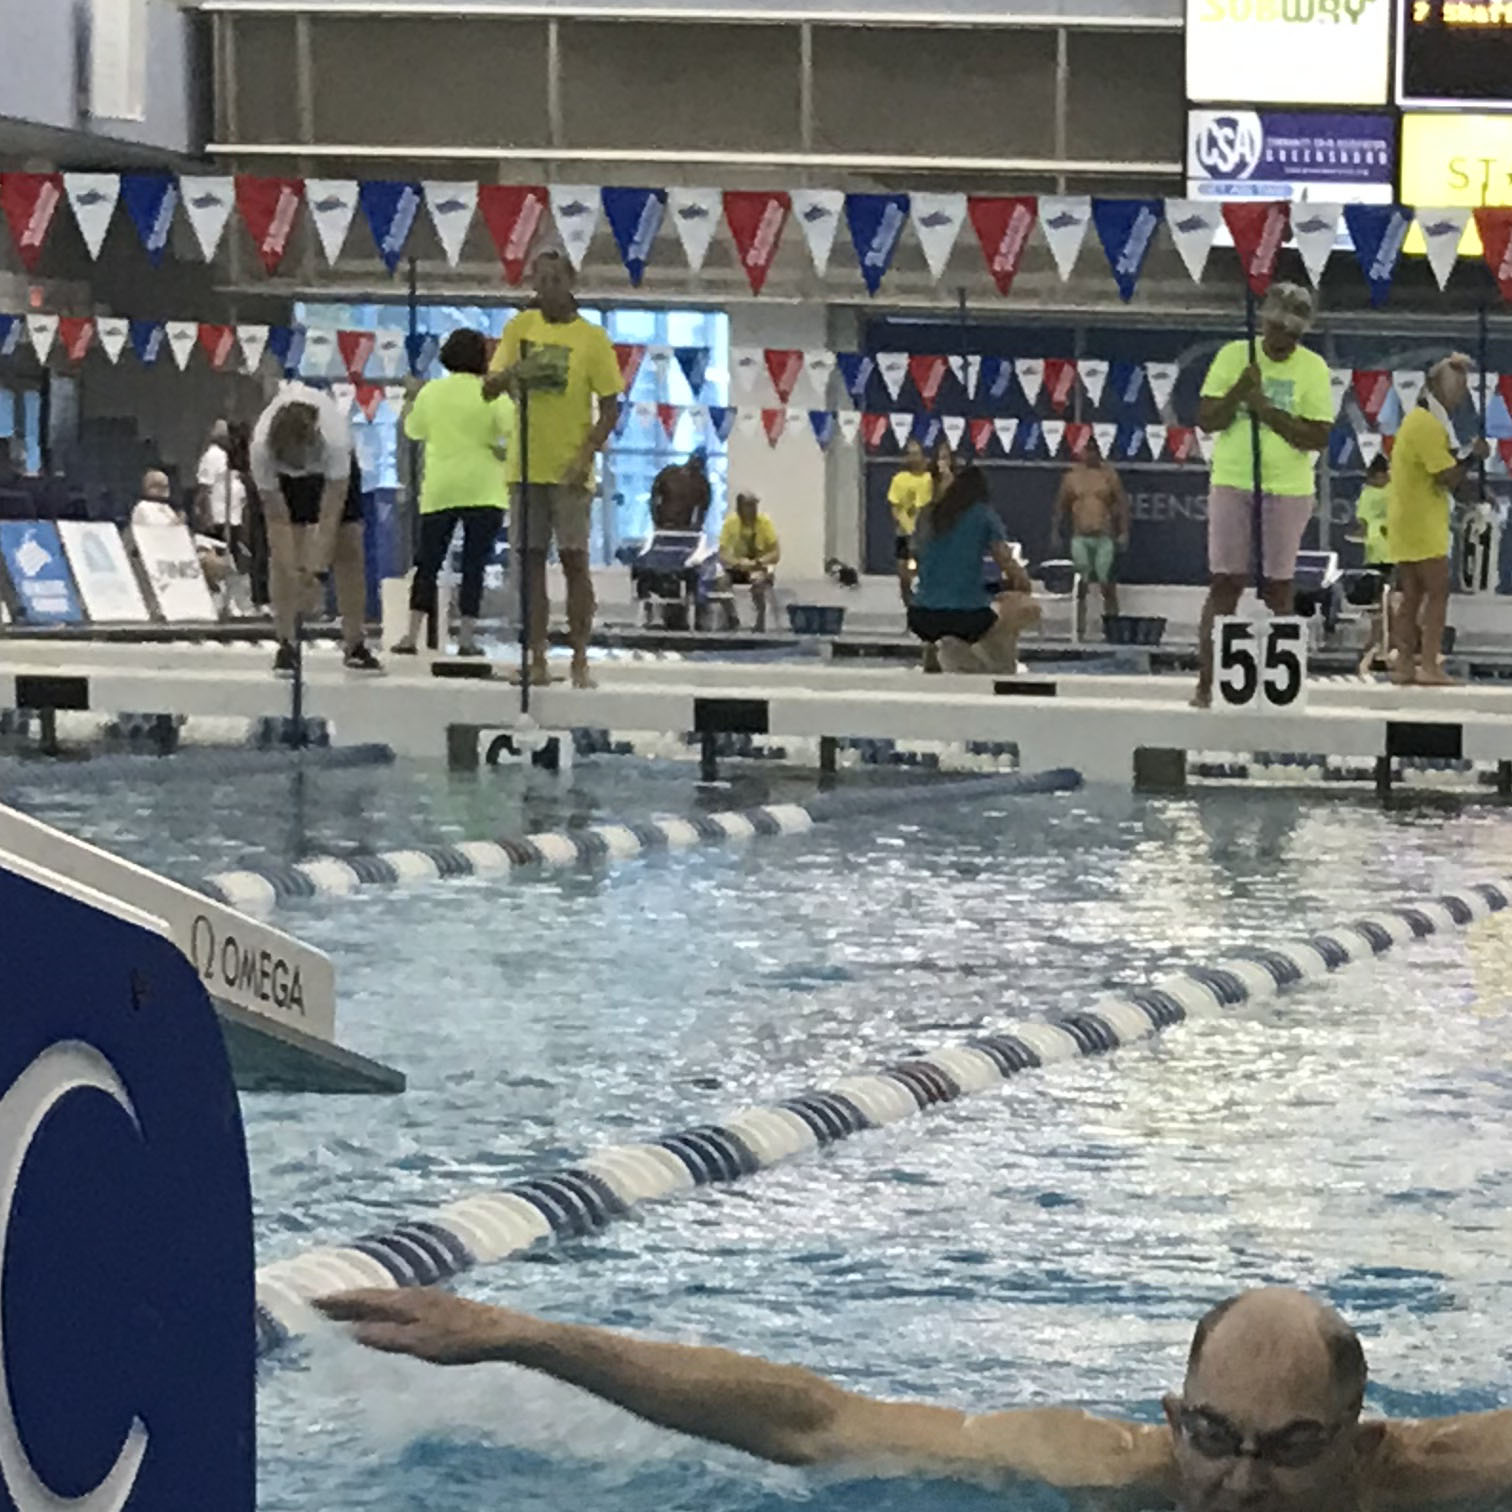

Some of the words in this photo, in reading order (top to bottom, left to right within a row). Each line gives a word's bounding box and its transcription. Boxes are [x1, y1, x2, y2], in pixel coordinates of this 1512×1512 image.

[1201, 118, 1253, 172] CSA
[1219, 622, 1302, 706] 55
[222, 936, 306, 1016] OMEGA
